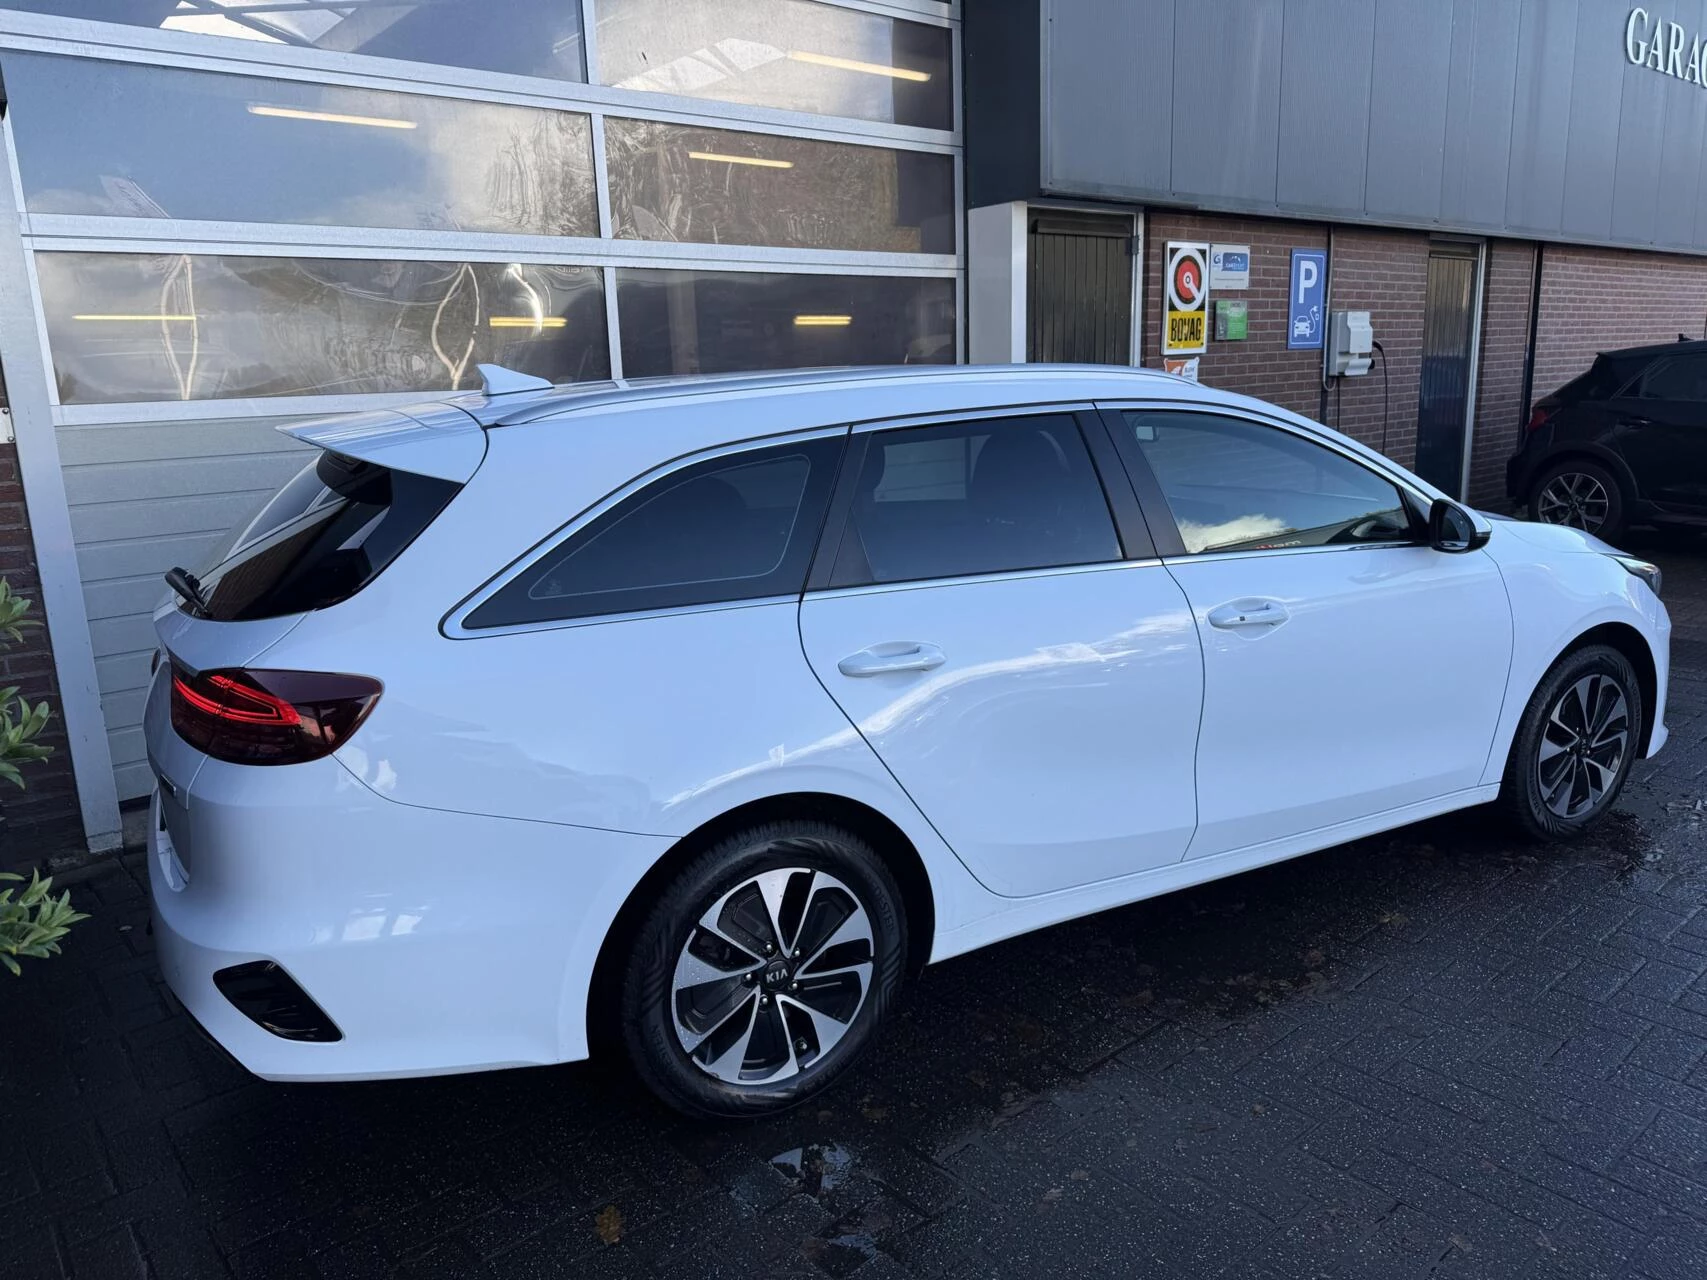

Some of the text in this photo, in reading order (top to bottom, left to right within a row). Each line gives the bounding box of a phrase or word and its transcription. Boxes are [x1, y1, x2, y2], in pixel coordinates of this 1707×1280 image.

[1626, 7, 1707, 88] GARA
[1299, 260, 1318, 304] P
[1170, 317, 1202, 342] BOVAG
[765, 968, 788, 983] KIA
